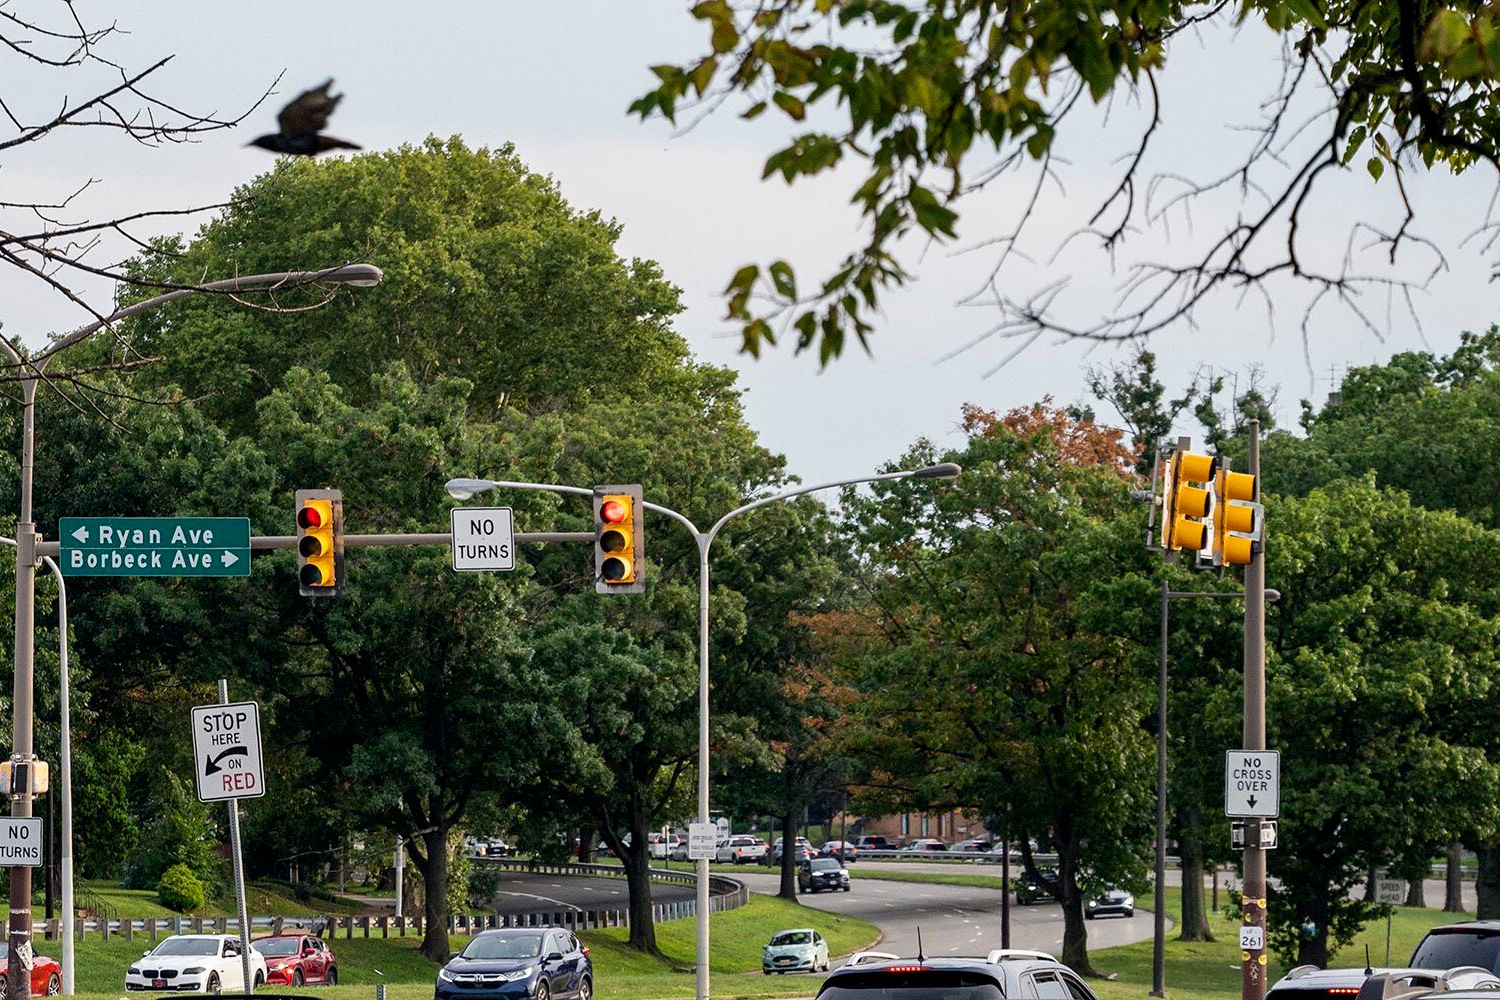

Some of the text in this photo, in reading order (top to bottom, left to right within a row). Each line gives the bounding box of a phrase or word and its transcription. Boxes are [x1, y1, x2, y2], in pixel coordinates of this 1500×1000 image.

[470, 519, 494, 535] NO
[99, 525, 213, 548] Ryan Ave
[458, 545, 509, 559] TURNS
[71, 550, 212, 568] Borbeck Ave
[203, 712, 247, 732] STOP
[212, 732, 241, 745] HERE
[228, 758, 242, 769] ON
[1243, 758, 1262, 767] NO
[1233, 769, 1272, 780] CROSS
[222, 772, 256, 791] RED
[1237, 781, 1268, 791] OVER
[8, 825, 30, 839] NO
[0, 846, 39, 858] TURNS
[1242, 936, 1261, 946] 261
